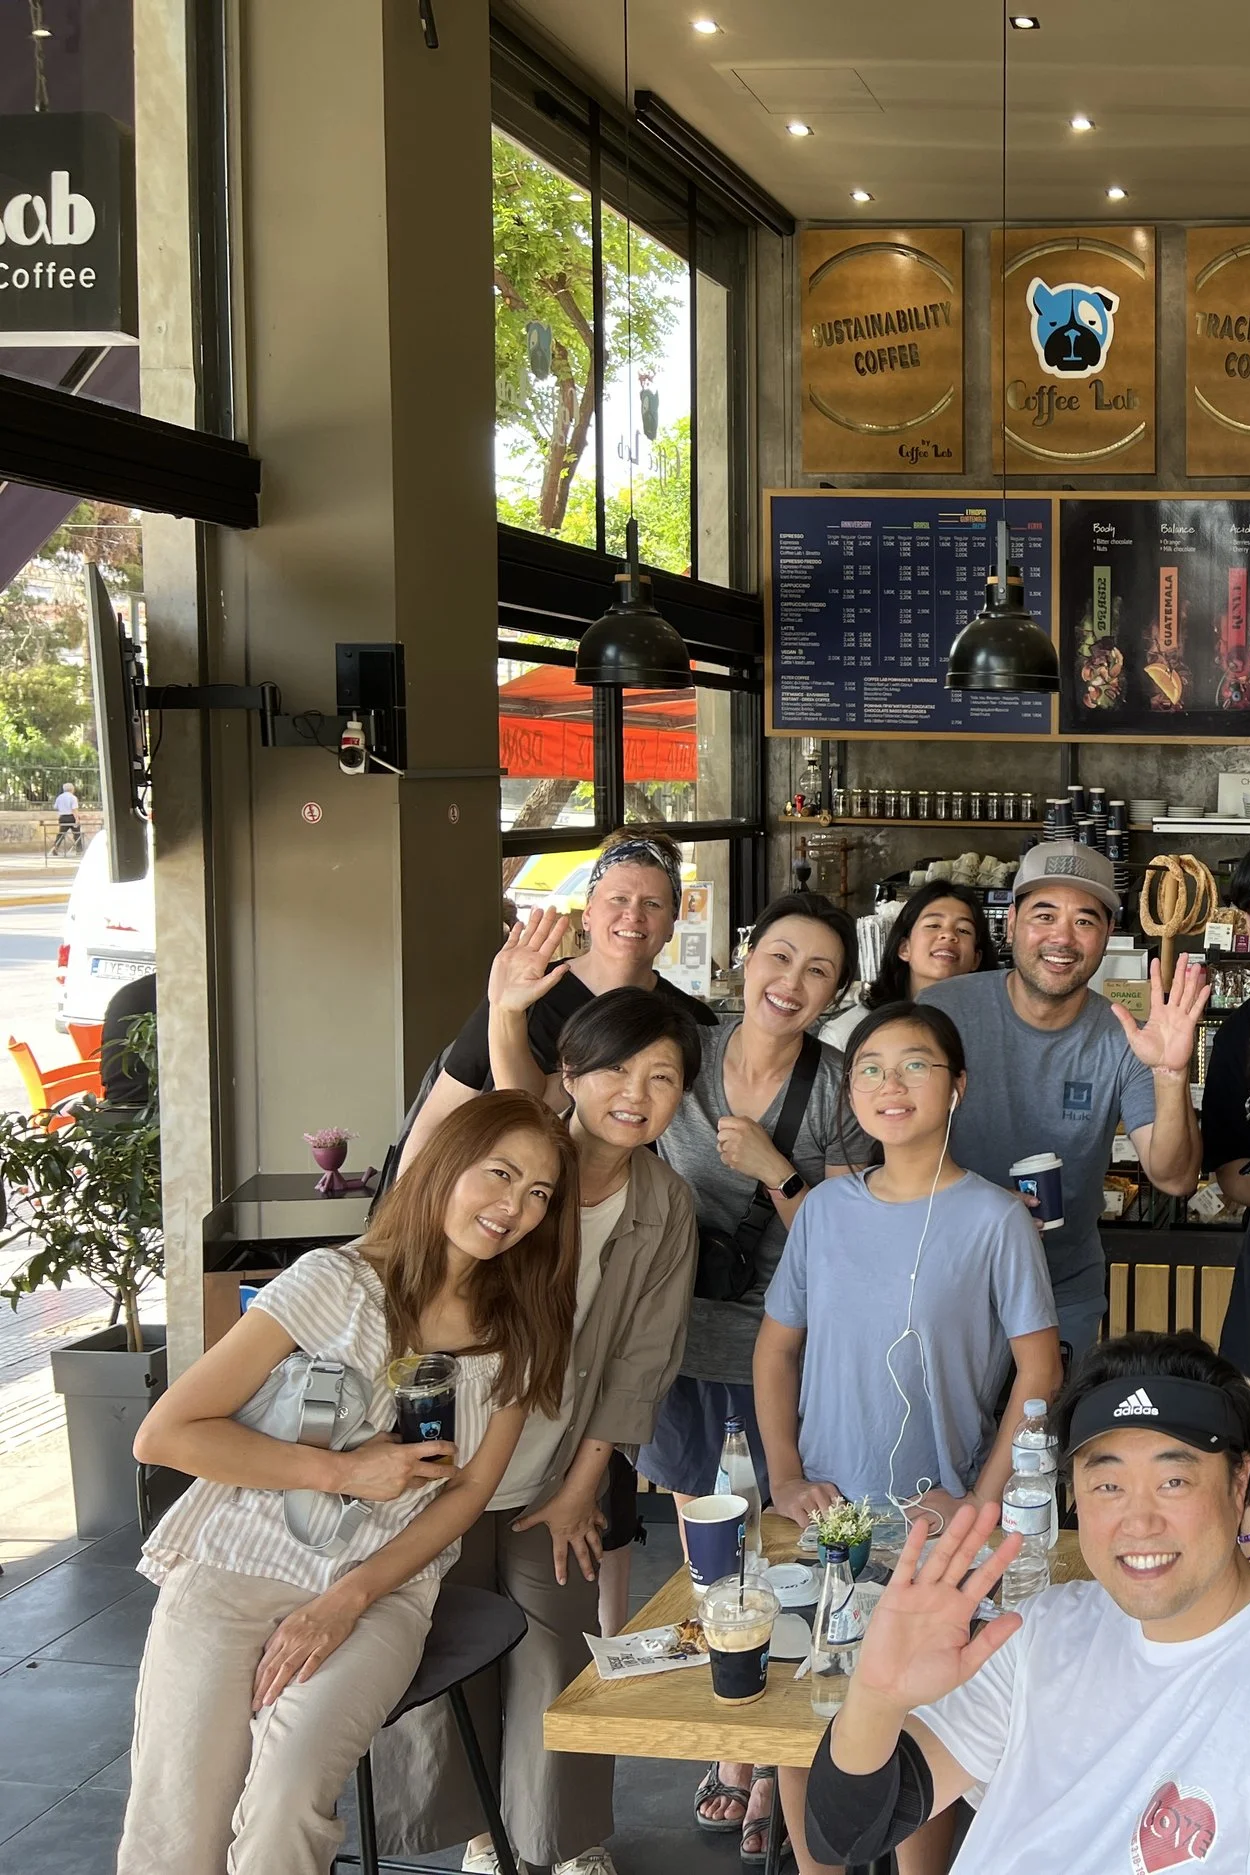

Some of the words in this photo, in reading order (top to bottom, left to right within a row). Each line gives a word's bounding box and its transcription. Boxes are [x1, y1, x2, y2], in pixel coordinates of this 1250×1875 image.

[0, 171, 96, 246] ab
[0, 261, 96, 289] Coffee
[811, 301, 951, 348] SUSTAINABILITY
[854, 343, 920, 377] COFFEE
[1005, 379, 1080, 427] Coffee
[1089, 379, 1139, 411] Lab
[899, 444, 928, 464] Coffee
[933, 445, 952, 458] Lab
[1093, 523, 1116, 538] Body
[1160, 523, 1195, 534] Balance
[1163, 574, 1174, 647] GUATEMALA
[1113, 1405, 1159, 1418] adidas
